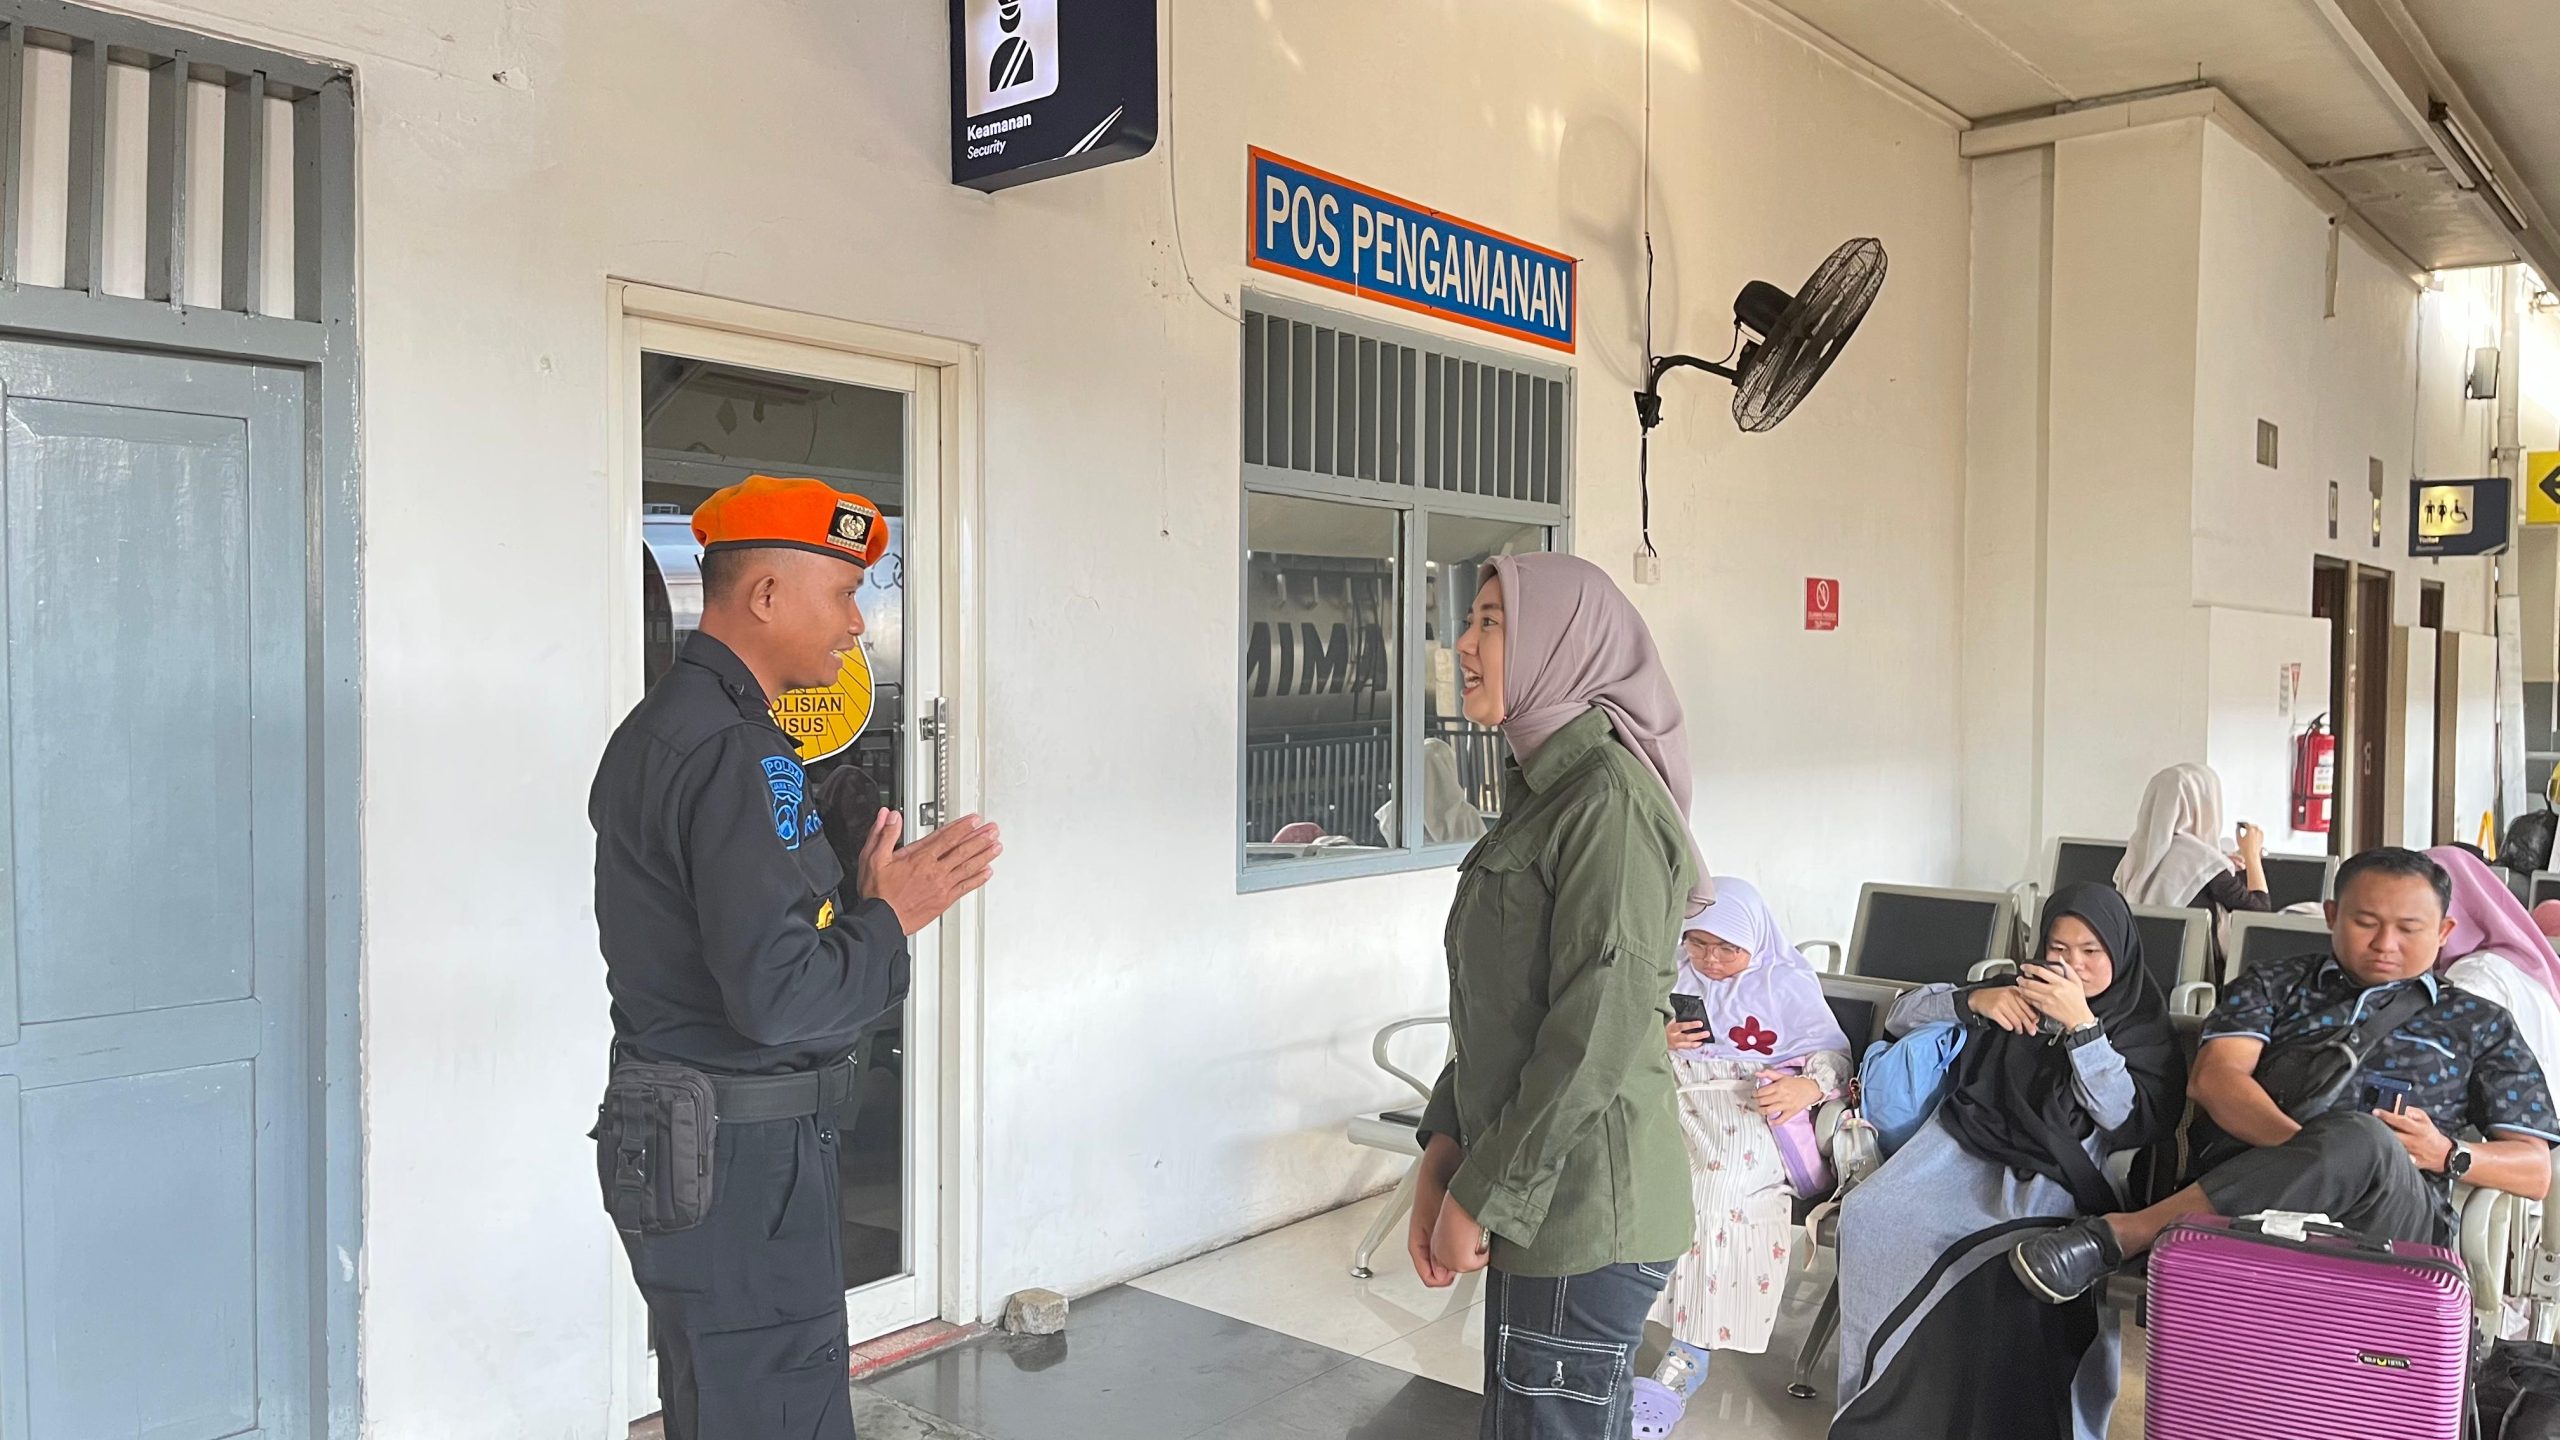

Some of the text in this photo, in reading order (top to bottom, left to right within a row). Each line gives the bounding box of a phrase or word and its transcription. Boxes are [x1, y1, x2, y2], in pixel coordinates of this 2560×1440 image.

[967, 113, 1032, 141] Keamanan
[967, 139, 1006, 160] Security
[1266, 175, 1567, 331] POS PENGAMANAN
